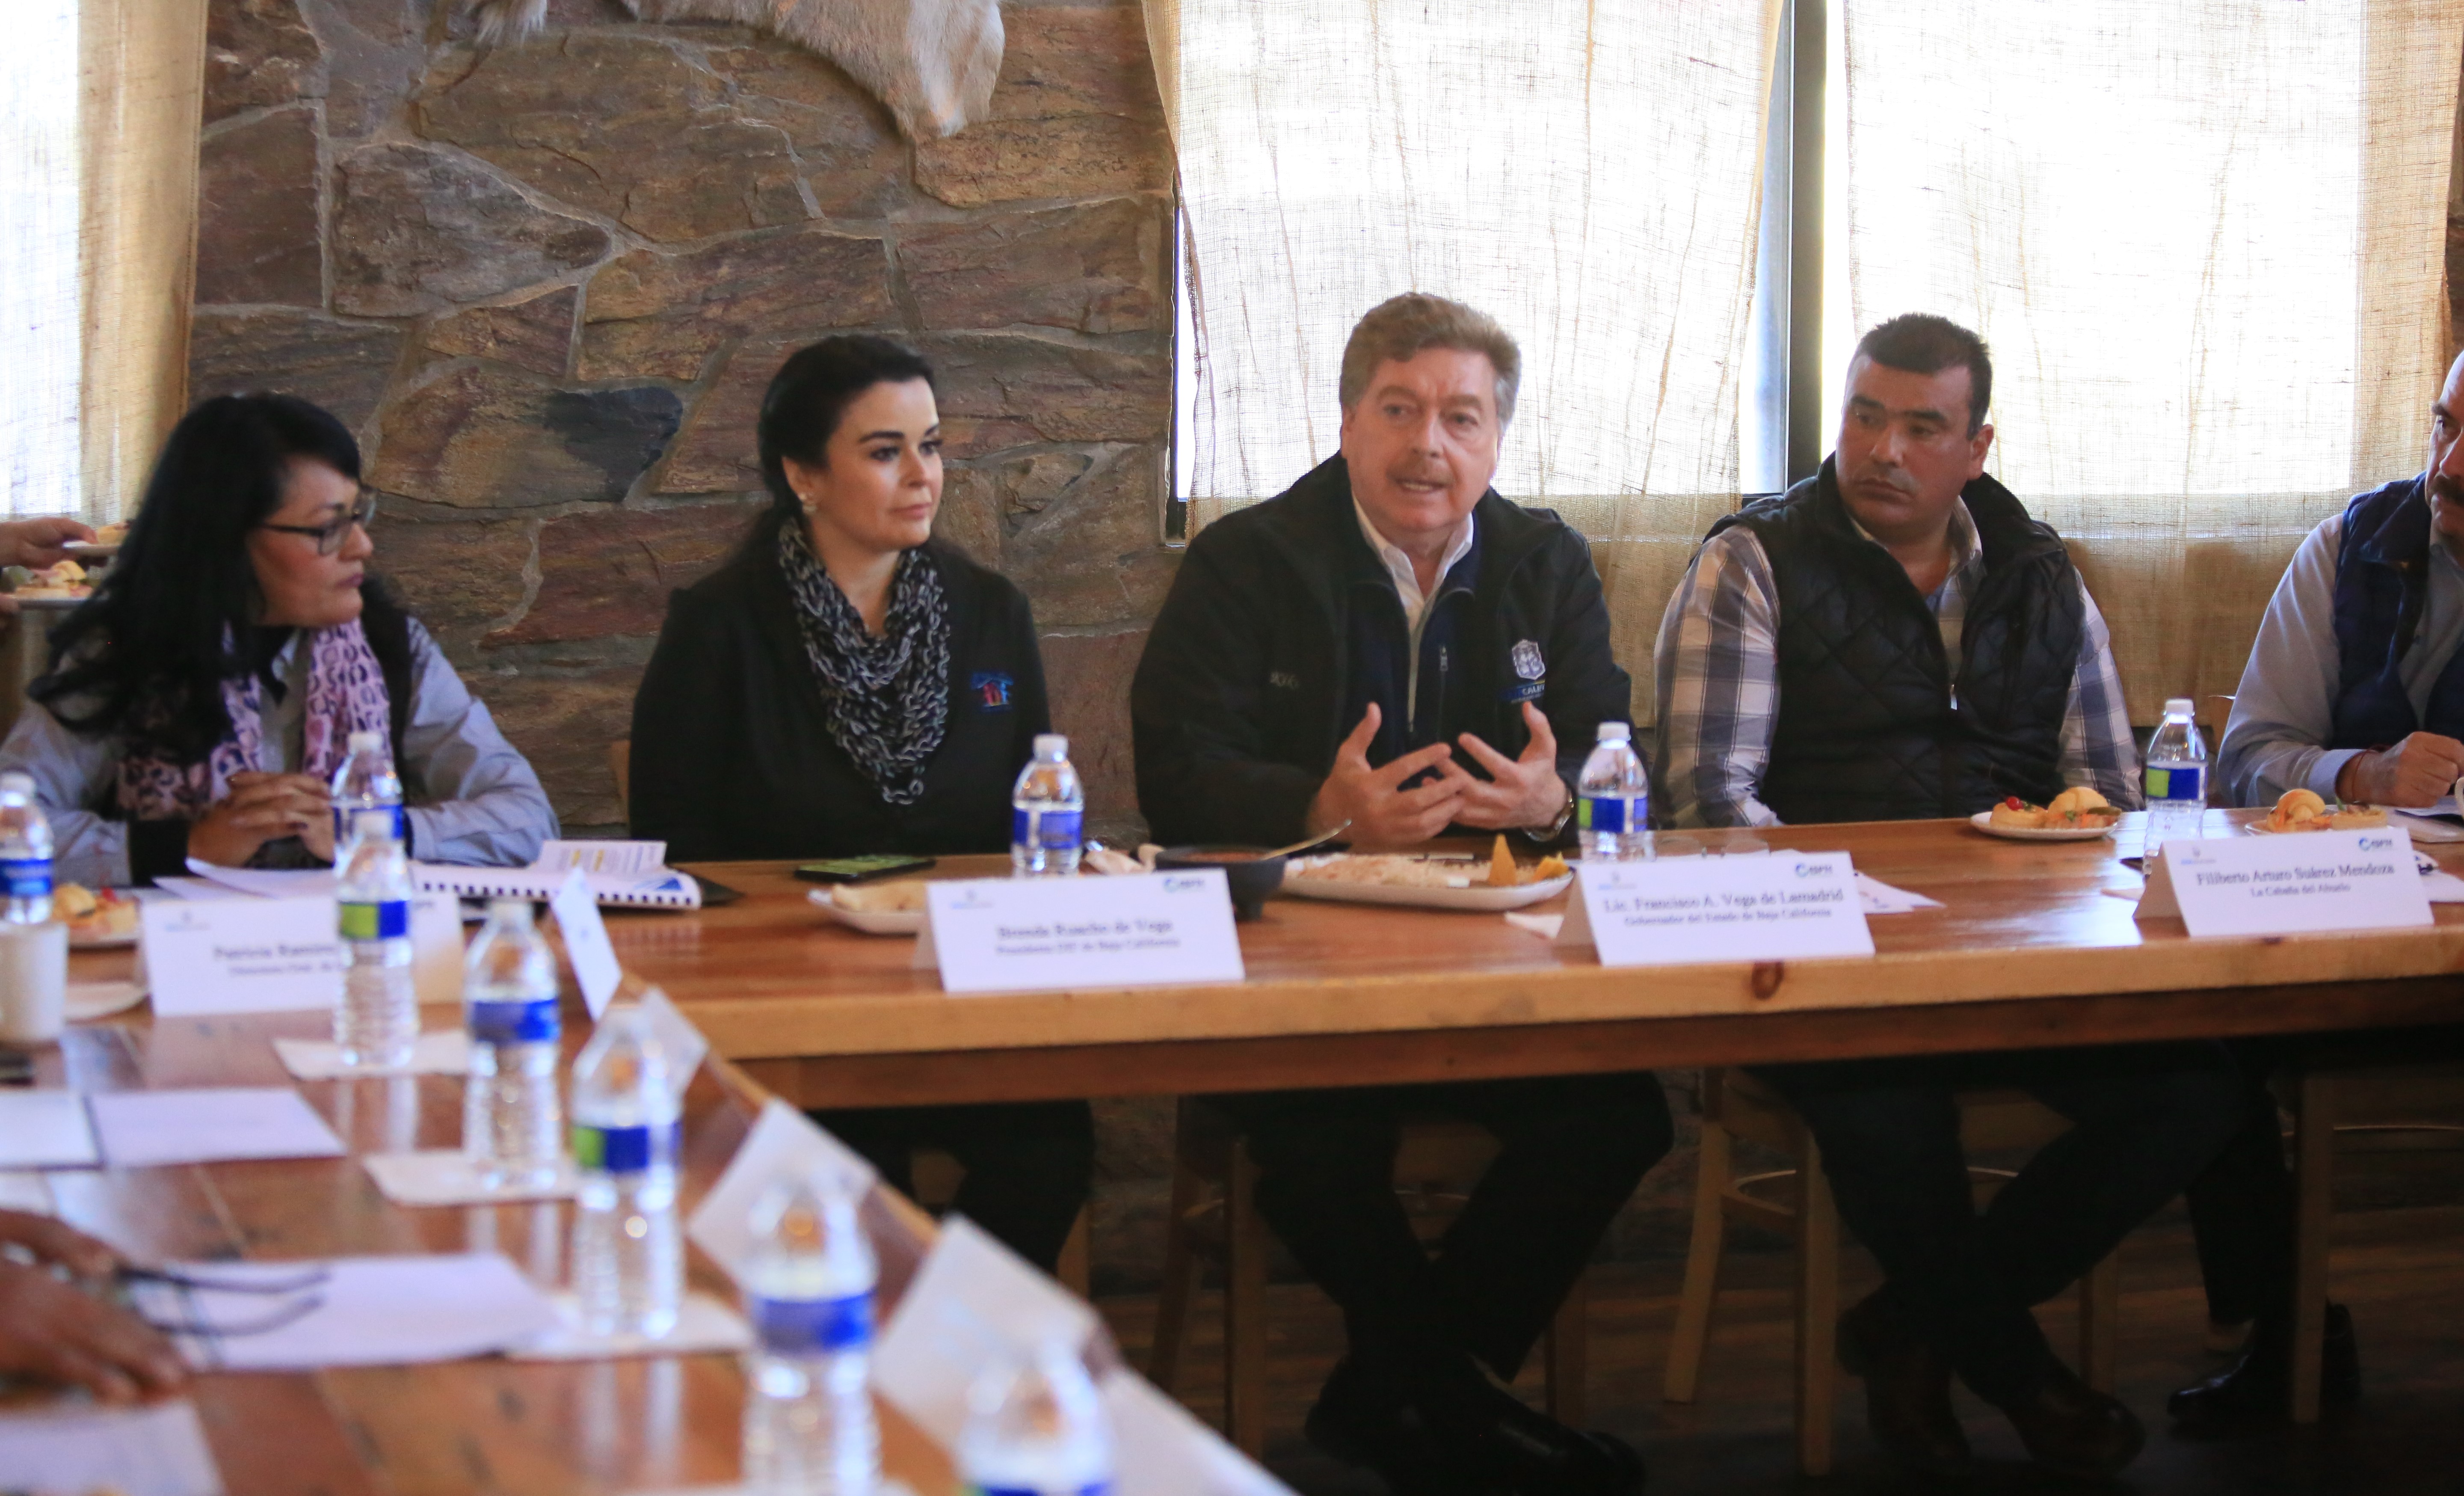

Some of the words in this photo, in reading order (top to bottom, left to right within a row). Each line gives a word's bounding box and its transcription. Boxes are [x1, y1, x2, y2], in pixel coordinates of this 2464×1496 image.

[2196, 871, 2250, 886] Filiberto
[2253, 869, 2293, 883] Arturo
[2338, 862, 2395, 876] Mendoza
[1603, 898, 1630, 913] Lic.
[1635, 896, 1701, 911] Francisco
[1703, 893, 1719, 908] A.
[1721, 892, 1757, 908] Vega
[1760, 891, 1777, 905] de
[1779, 888, 1843, 903] Lamadrid
[2251, 887, 2263, 897] La
[2301, 884, 2316, 894] del
[1624, 915, 1684, 926] Gobernador
[1687, 914, 1701, 923] del
[1705, 912, 1737, 923] Estado
[1742, 911, 1753, 920] de
[1756, 910, 1779, 922] Baja
[1781, 908, 1832, 919] California
